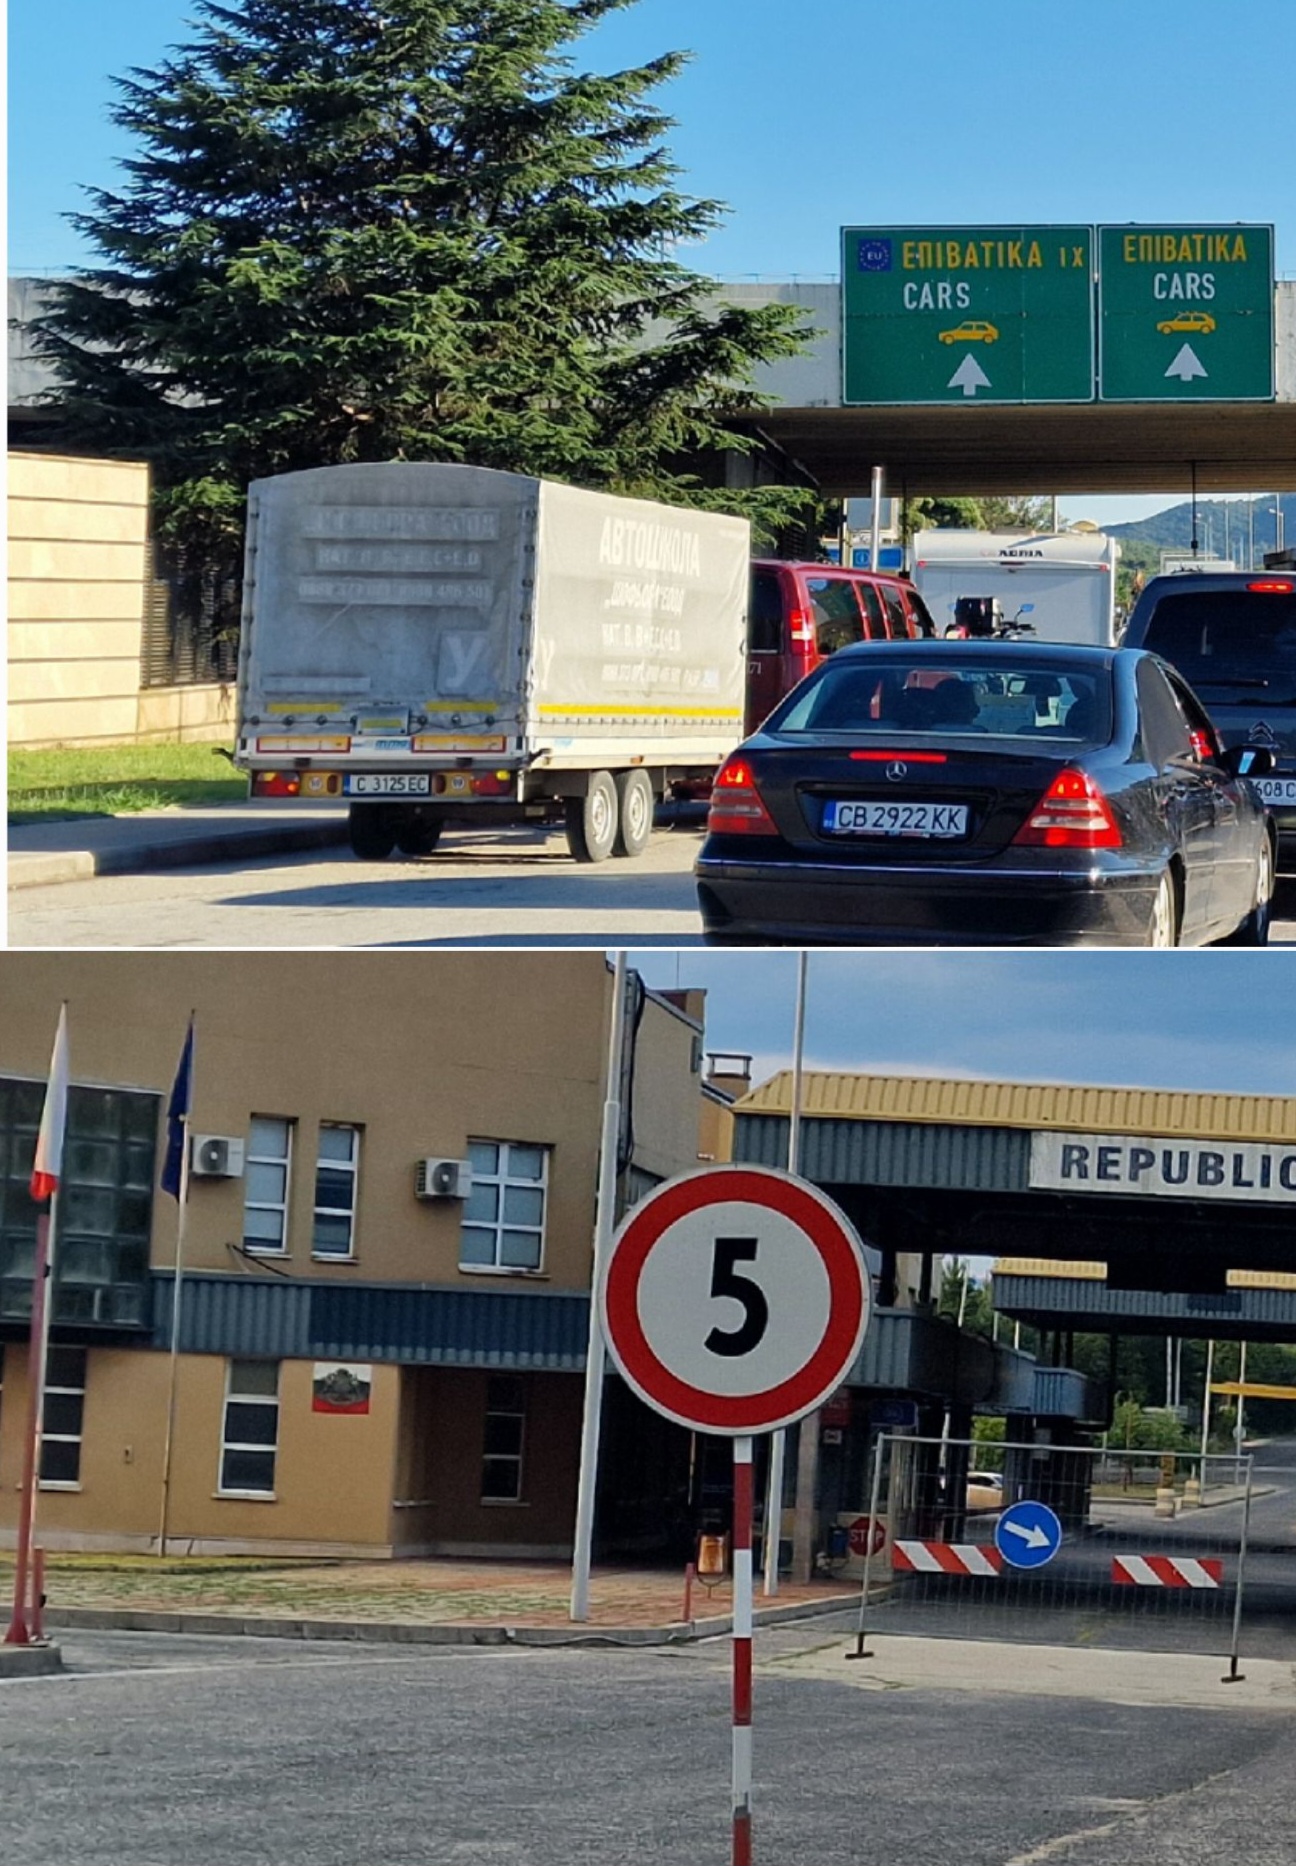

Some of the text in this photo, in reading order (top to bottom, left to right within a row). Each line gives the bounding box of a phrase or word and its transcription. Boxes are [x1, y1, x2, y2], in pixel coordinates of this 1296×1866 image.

[867, 251, 882, 261] EU
[902, 241, 1043, 269] ΕΠΙΒΑΤΙΚΑ
[1123, 234, 1247, 263] ΕΠΙΒΑΤΙΚΑ
[903, 282, 970, 310] CARS
[1153, 273, 1215, 300] CARS
[600, 515, 700, 578] АВТОШКОЛА
[357, 777, 427, 791] C 3125 EC
[839, 805, 961, 830] CB 2922 KK
[703, 1237, 768, 1357] 5
[851, 1530, 885, 1542] STP
